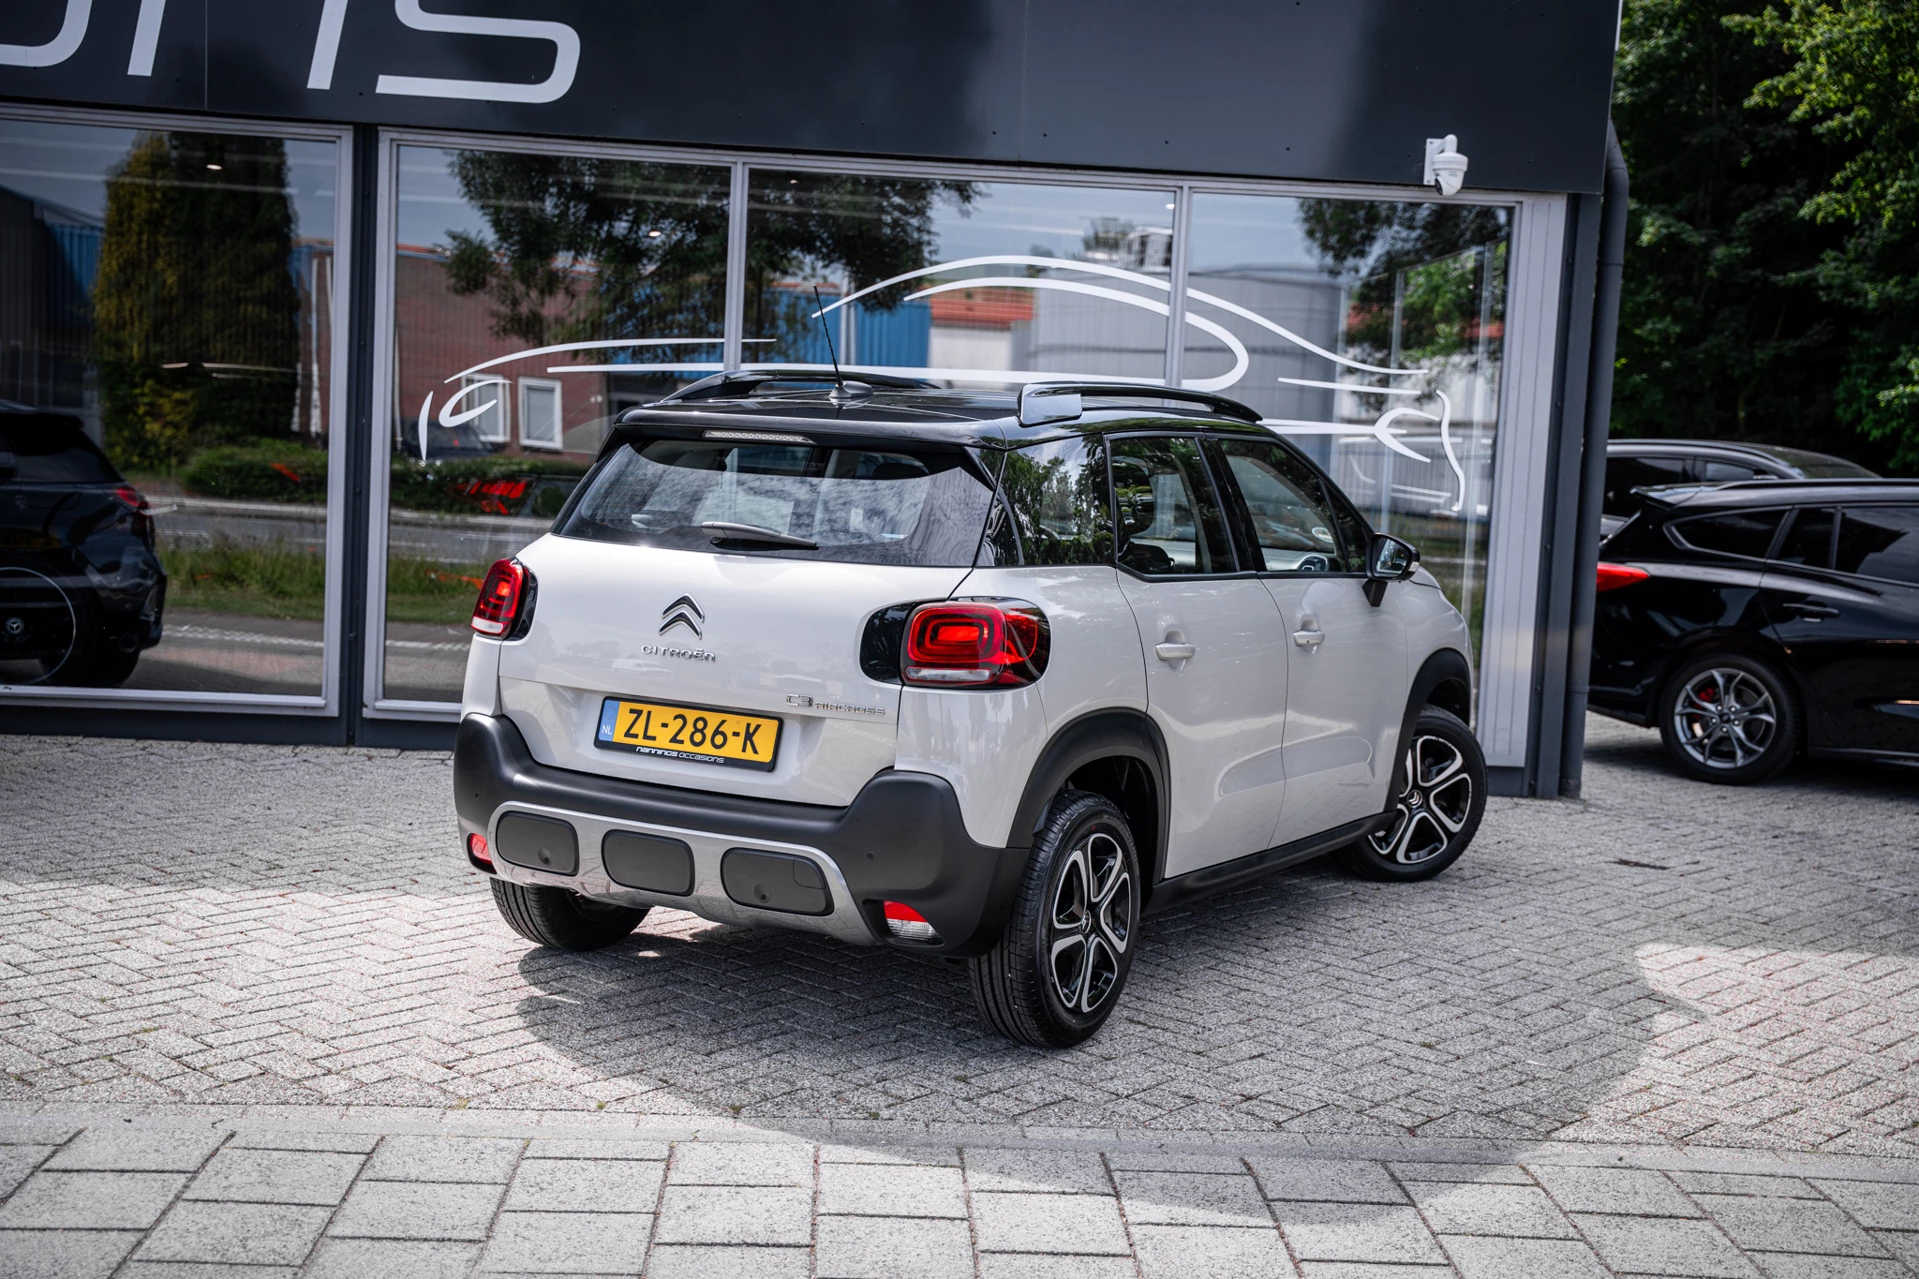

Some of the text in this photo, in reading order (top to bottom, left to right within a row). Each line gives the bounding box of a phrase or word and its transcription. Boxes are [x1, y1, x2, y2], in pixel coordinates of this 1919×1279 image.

[641, 644, 716, 662] CITROËN
[786, 693, 886, 716] C3 AIRCROSS
[601, 724, 613, 735] NL
[623, 708, 762, 755] ZL-286-K
[635, 746, 725, 764] nannings occasions
